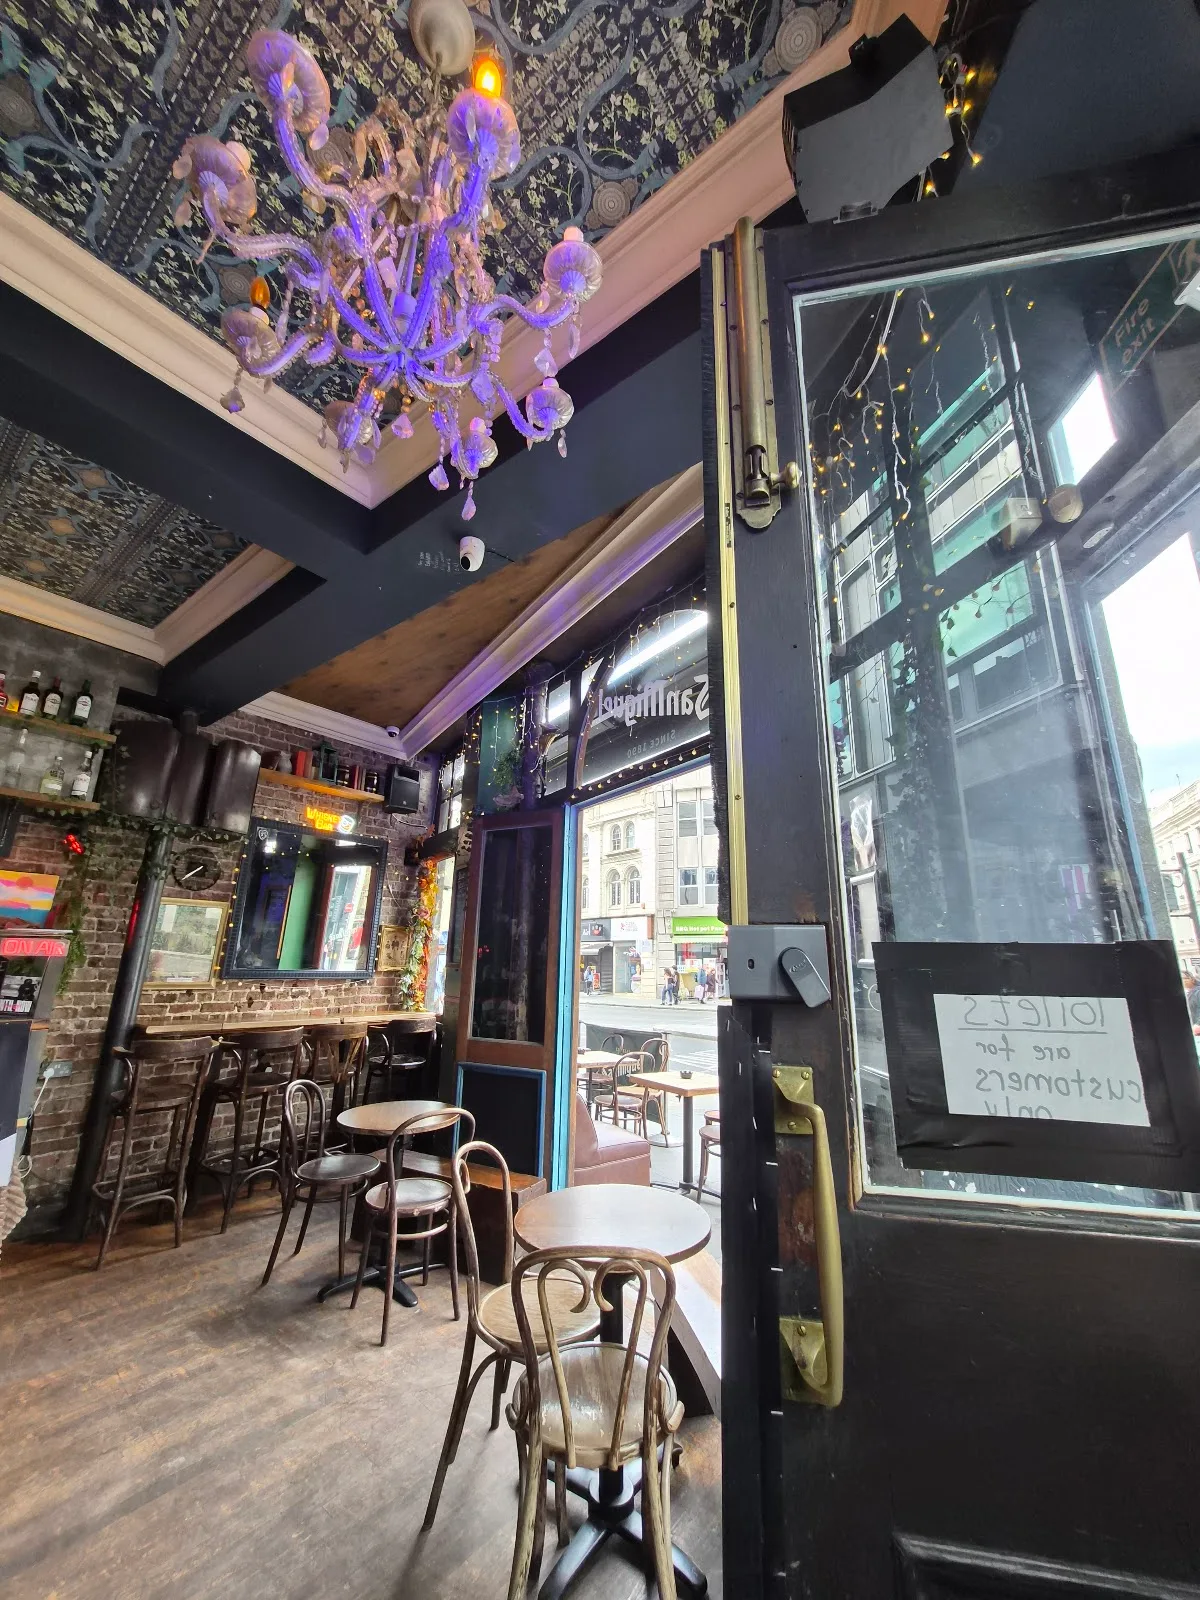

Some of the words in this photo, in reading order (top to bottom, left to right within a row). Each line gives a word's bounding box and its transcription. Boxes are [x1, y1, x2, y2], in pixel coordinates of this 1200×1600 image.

[1115, 298, 1149, 347] Fire
[1122, 317, 1155, 365] exit
[3, 939, 34, 955] ON
[35, 940, 66, 955] AIR
